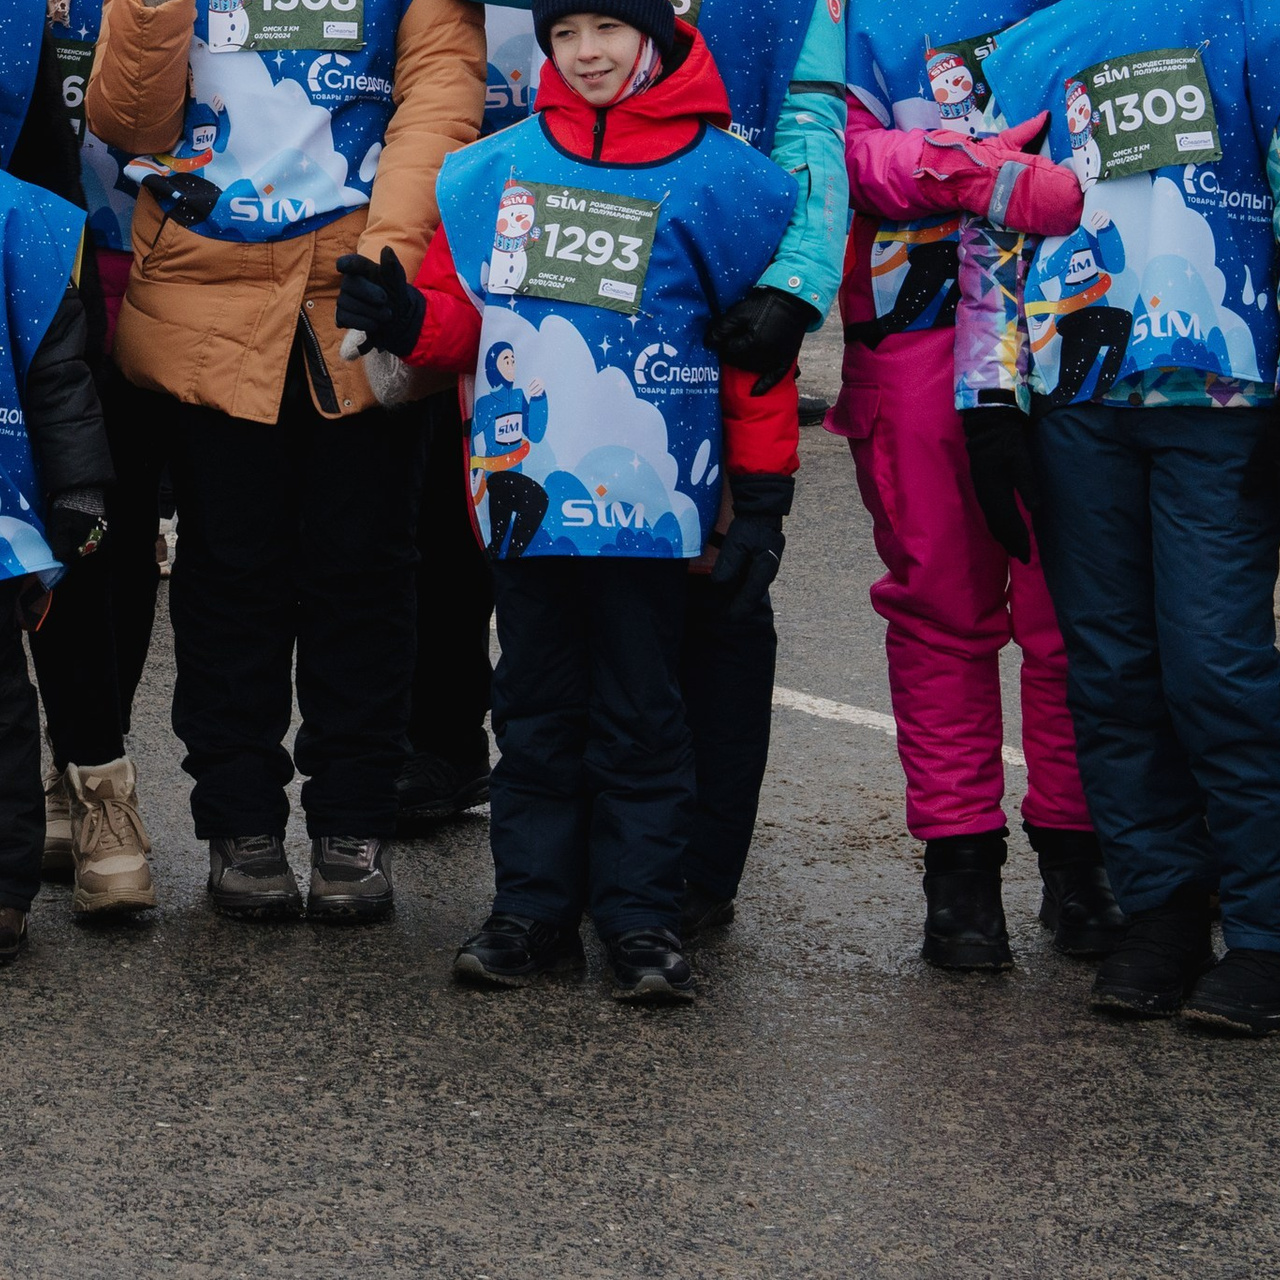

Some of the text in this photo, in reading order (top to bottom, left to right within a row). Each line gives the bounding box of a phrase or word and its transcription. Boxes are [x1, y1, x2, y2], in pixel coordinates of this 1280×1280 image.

[1132, 57, 1196, 70] РОЖДЕСТВЕНСКИЙ
[1133, 64, 1187, 77] ПОЛУМАРАФОН
[1098, 84, 1206, 136] 1309
[1113, 148, 1133, 158] ОМСК
[1106, 153, 1143, 168] 07/01/2024
[1187, 196, 1216, 206] ТОВАРЫ
[588, 207, 641, 222] ПОЛУМАРАФОН
[589, 200, 654, 218] РОЖДЕСТВЕНСКИЙ
[544, 223, 643, 271] 1293
[528, 278, 566, 289] 07/01/2024
[538, 272, 558, 281] ОМСК
[564, 275, 576, 283] КМ
[637, 386, 667, 394] ТОВАРЫ
[670, 387, 684, 395] ДЛЯ
